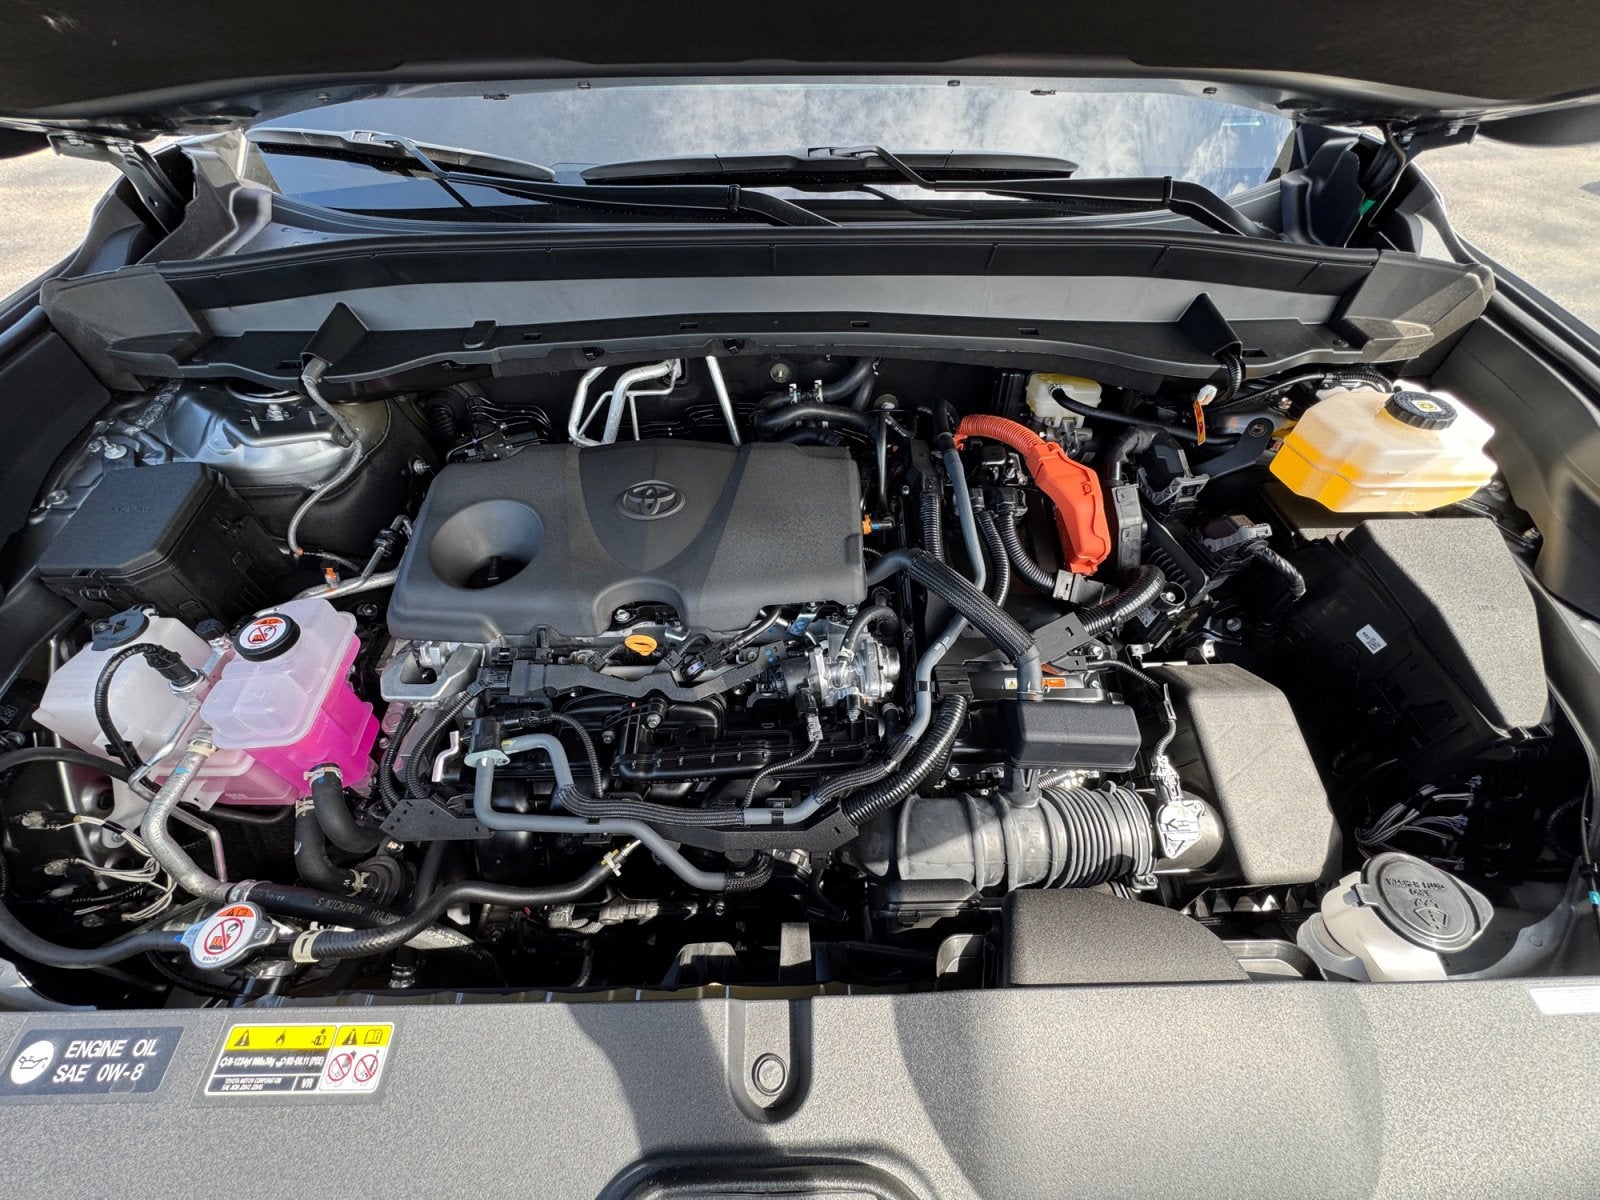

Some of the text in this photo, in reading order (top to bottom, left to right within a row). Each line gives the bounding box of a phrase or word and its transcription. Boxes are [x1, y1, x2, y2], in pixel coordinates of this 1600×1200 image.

[64, 1038, 158, 1058] ENGINE OIL
[52, 1062, 145, 1084] SAE 0W-8
